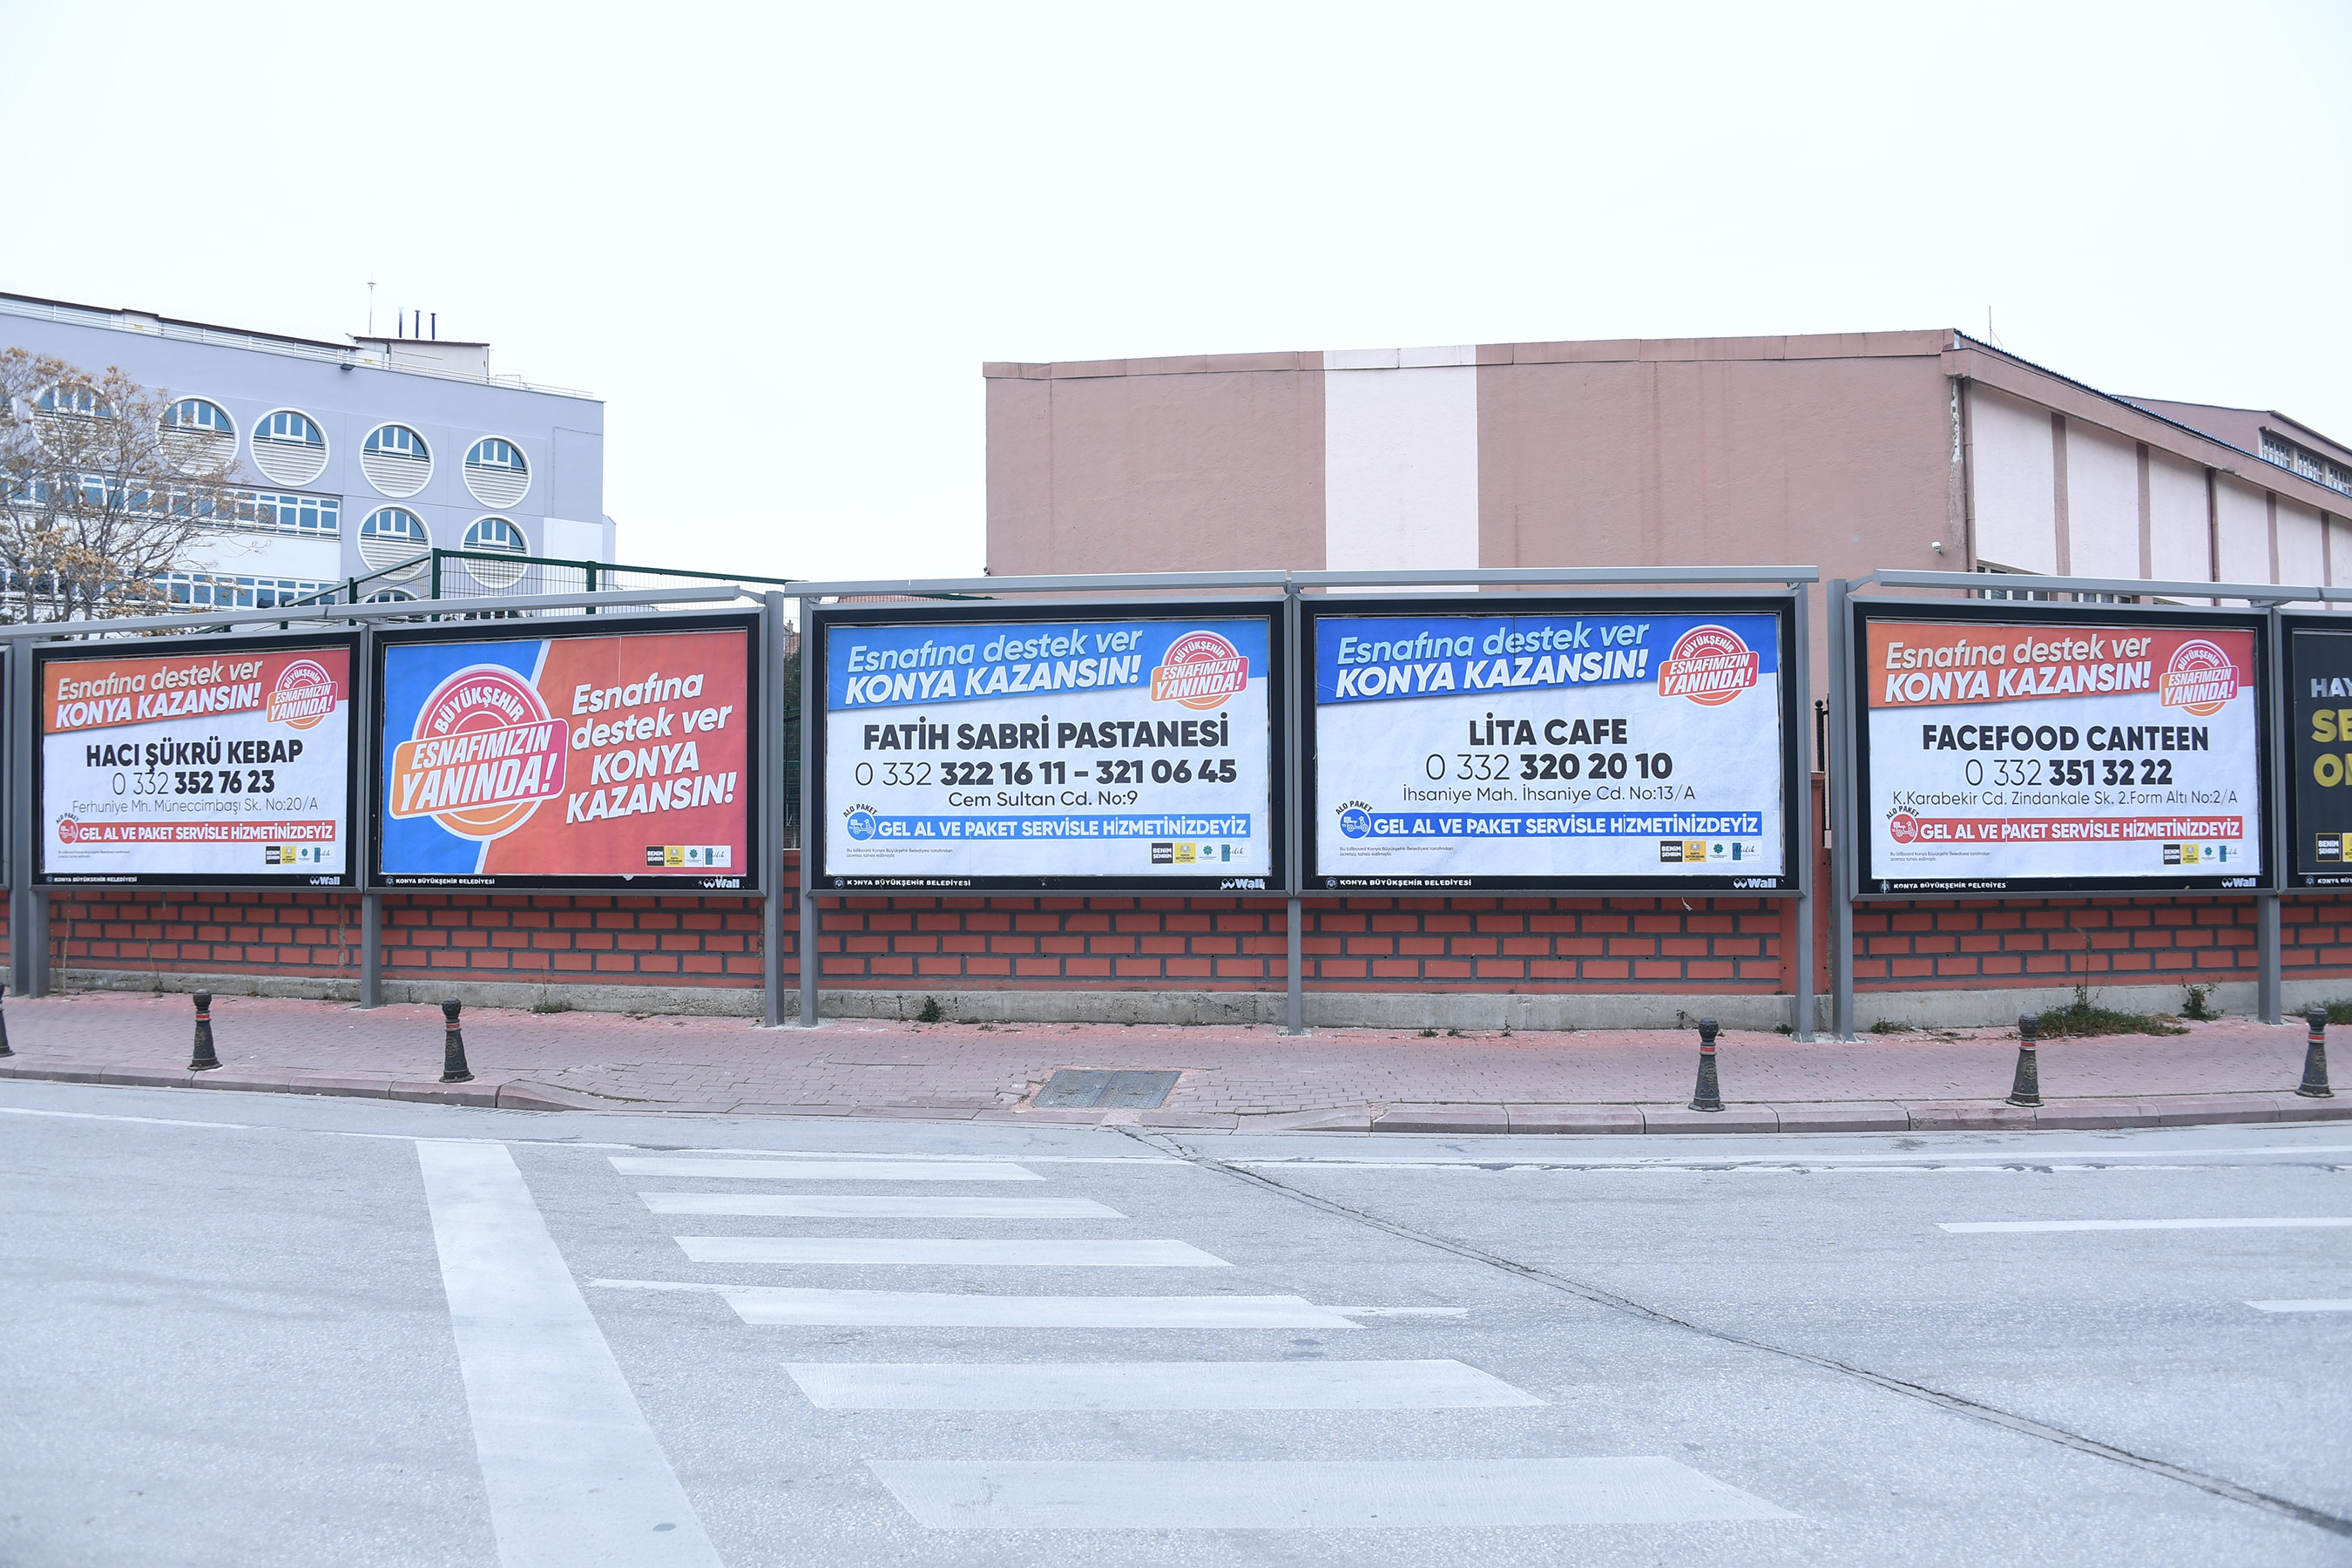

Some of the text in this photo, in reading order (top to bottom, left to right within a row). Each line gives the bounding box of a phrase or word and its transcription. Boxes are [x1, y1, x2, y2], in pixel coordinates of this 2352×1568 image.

[848, 628, 1143, 672] Esnafına destek ver
[1173, 640, 1226, 664] BÜYÜKŞEHİR
[1337, 621, 1650, 665] Esnafına destek ver
[1681, 635, 1734, 658] BÜYÜKŞEHİR
[1886, 633, 2152, 670] Esnafına destek ver
[1161, 659, 1240, 680] ESNAFIMIZIN
[1335, 648, 1649, 698] KONYA KAZANSIN!
[1670, 654, 1750, 676] ESNAFIMIZIN
[2178, 649, 2220, 671] BÜYÜKŞEHİR
[57, 659, 263, 701] Esnafına destek ver
[845, 654, 1142, 705] KONYA KAZANSIN!
[1156, 672, 1243, 700] YANINDA!
[1663, 667, 1754, 695] YANINDA!
[1884, 660, 2152, 703] KONYA KAZANSIN!
[2167, 667, 2233, 686] ESNAFIMIZIN
[56, 682, 262, 728] KONYA KAZANSIN!
[274, 684, 331, 704] ESNAFIMIZIN
[571, 672, 705, 715] Esnafına
[2164, 680, 2234, 706] YANINDA!
[270, 695, 333, 720] YANINDA!
[433, 686, 524, 733] BÜYÜKŞEHİR
[571, 705, 733, 750] destek ver
[864, 711, 1228, 750] FATİH SABRİ PASTANESİ
[1470, 712, 1627, 746] LİTA CAFE
[1923, 724, 2208, 751] FACEFOOD CANTEEN
[86, 736, 303, 773] HACI ŞÜKRÜ KEBAP
[411, 724, 553, 770] ESNAFIMIZIN
[590, 740, 700, 786] KONYA
[855, 761, 873, 786] 0
[882, 761, 932, 786] 332
[940, 760, 994, 786] 322
[999, 760, 1033, 786] 16
[1038, 760, 1065, 784] 11
[1096, 760, 1144, 784] 321
[1151, 759, 1193, 784] 06
[1197, 759, 1237, 783] 45
[1426, 752, 1673, 780] 0 332 320 20 10
[1965, 758, 2173, 786] 0 332 351 32 22
[112, 769, 275, 795] 0 332 352 76 23
[400, 753, 558, 812] YANINDA!
[1402, 783, 1695, 804] İhsaniye Mah. İhsaniye Cd. No:13/A
[72, 795, 318, 816] Ferhuniye Mh. Müneccimbaşı Sk. No:20/A
[566, 771, 737, 824] KAZANSIN!
[949, 790, 1138, 807] Cem Sultan Cd. No:9
[1335, 800, 1374, 815] ALO PAKET
[1893, 788, 2238, 805] K.Karabekir Cd. Zindankale Sk. 2.Form Altı No:2/A
[842, 803, 878, 818] ALO PAKET
[1374, 813, 1758, 835] GEL AL VE PAKET SERVİSLE HİZMETİNİZDEYİZ
[79, 821, 333, 841] GEL AL VE PAKET SERVİSLE HİZMETİNİZDEYİZ
[878, 815, 1247, 836] GEL AL VE PAKET SERVİSLE HİZMETİNİZDEYİZ
[1920, 818, 2240, 840] GEL AL VE PAKET SERVİSLE HİZMETİNİZDEYİZ
[1369, 878, 1423, 887] BÜYÜKŞEHİR
